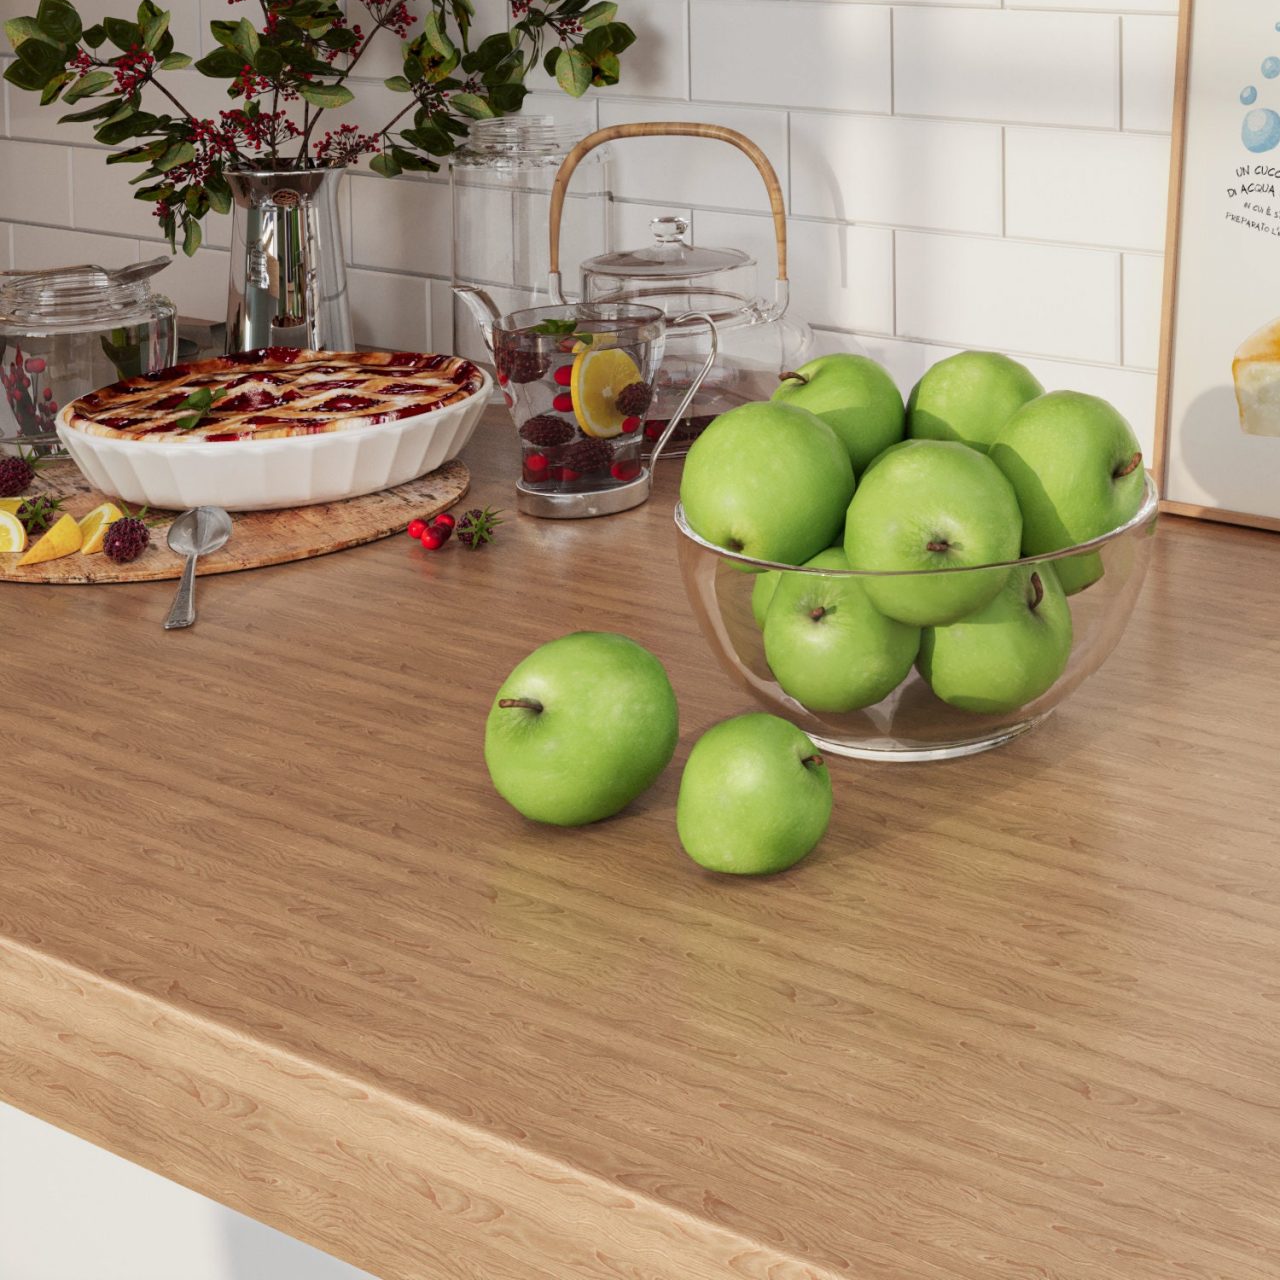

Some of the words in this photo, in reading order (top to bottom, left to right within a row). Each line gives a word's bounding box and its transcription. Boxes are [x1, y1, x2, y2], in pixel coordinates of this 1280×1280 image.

[1236, 165, 1249, 177] UN
[1227, 188, 1237, 197] DI
[1241, 183, 1275, 197] ACQUA
[1226, 211, 1270, 232] PREPARATO
